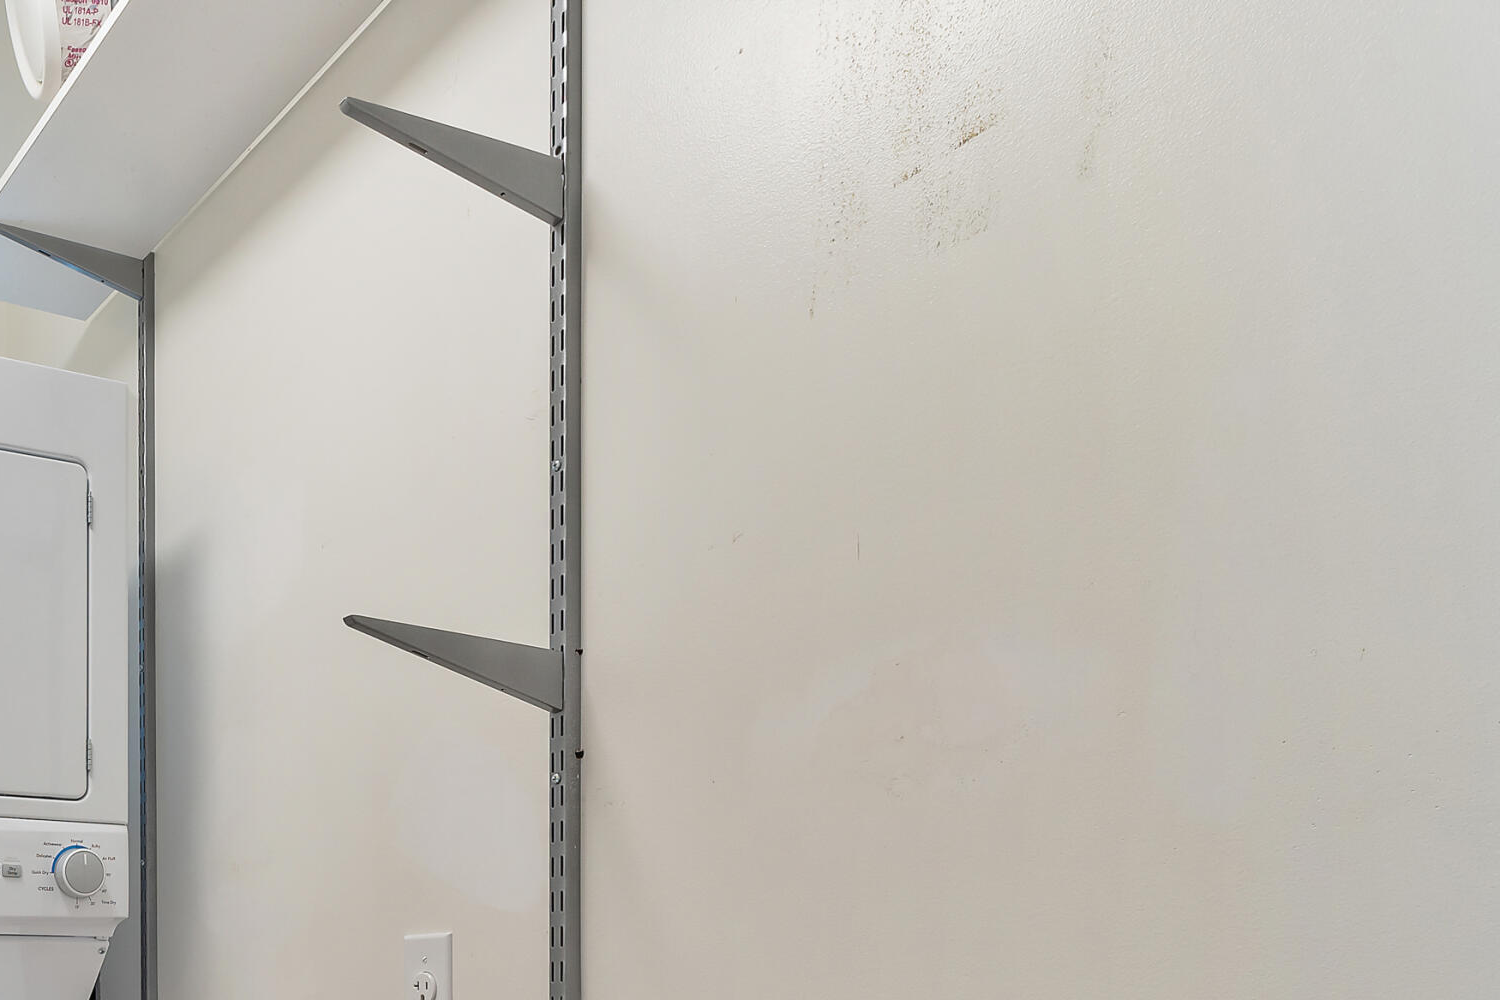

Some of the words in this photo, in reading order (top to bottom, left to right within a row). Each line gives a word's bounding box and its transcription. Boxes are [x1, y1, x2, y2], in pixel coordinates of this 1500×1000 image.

[62, 6, 72, 14] UL
[74, 7, 99, 15] 181A-P
[62, 17, 72, 25] UL
